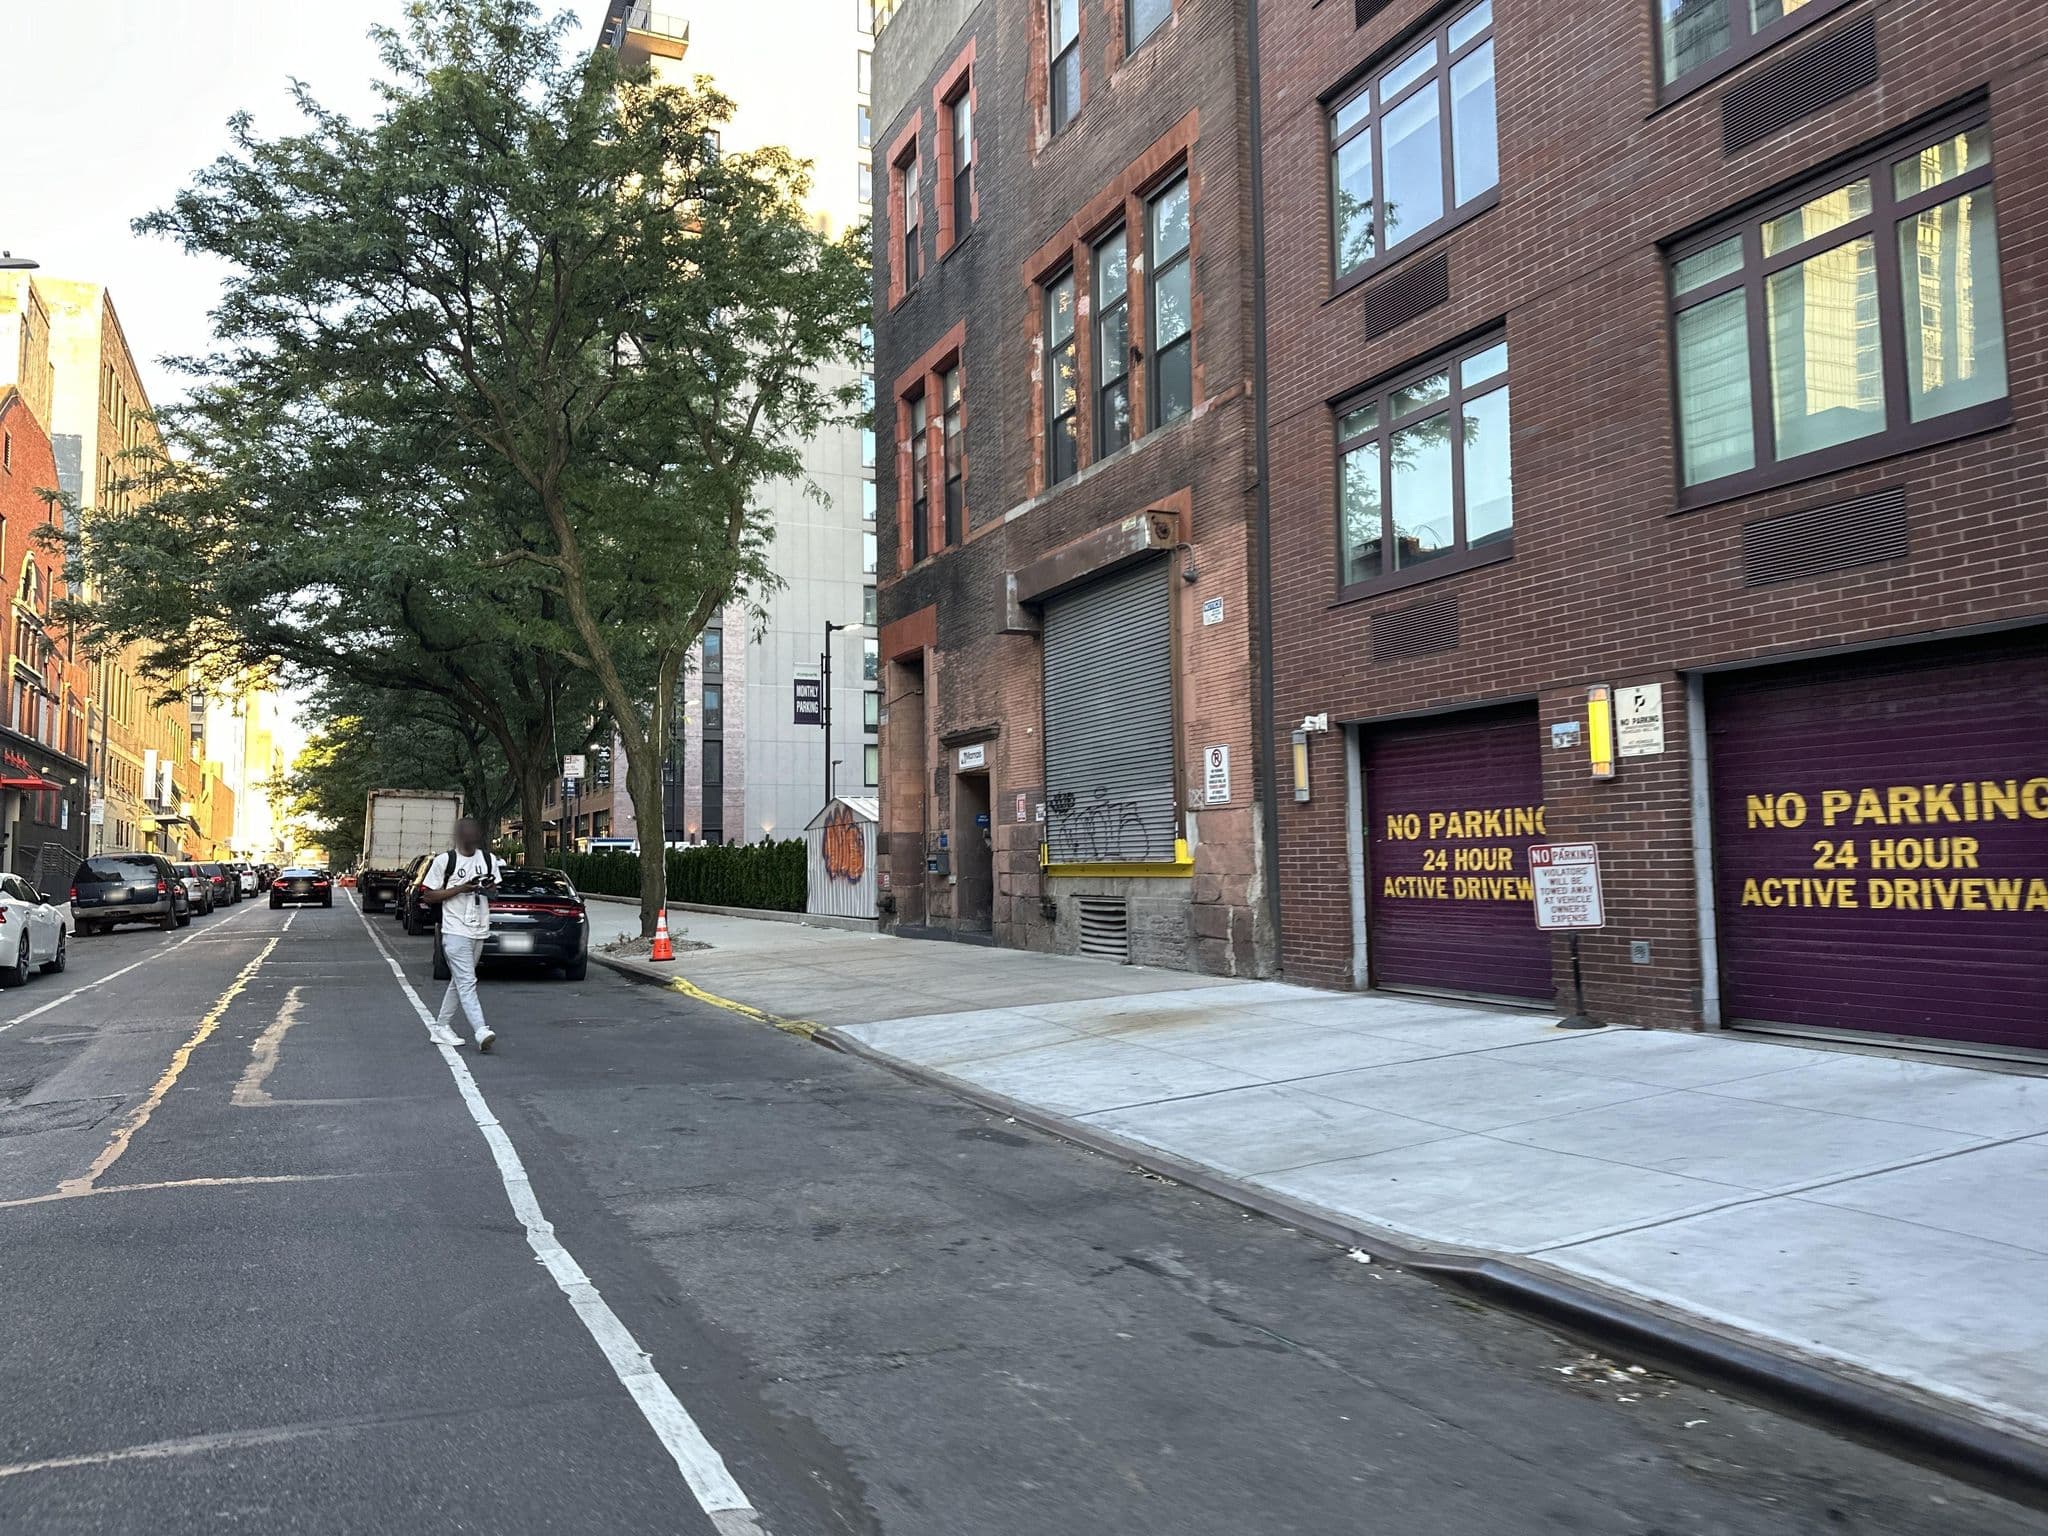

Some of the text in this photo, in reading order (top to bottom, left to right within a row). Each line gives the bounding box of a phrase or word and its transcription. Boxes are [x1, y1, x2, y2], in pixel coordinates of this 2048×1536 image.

[796, 684, 819, 698] MONTHLY
[796, 700, 819, 714] PARKING
[1620, 715, 1660, 726] NO PARKING
[1746, 777, 2048, 829] NO PARKING
[1386, 814, 1422, 841] NO
[1422, 847, 1514, 872] 24 HOUR
[1531, 848, 1594, 864] NO PARKING
[1812, 836, 1980, 871] 24 HOUR
[1542, 866, 1588, 877] VIOLATORS
[1548, 876, 1583, 886] WILL BE
[1384, 876, 1535, 901] ACTIVE DRIVEW
[1540, 885, 1593, 895] TOWED AWAY
[1741, 877, 2048, 912] ACTIVE DRIVEWA
[1544, 894, 1593, 904] AT VEHICLE
[1551, 913, 1589, 923] EXPENSE
